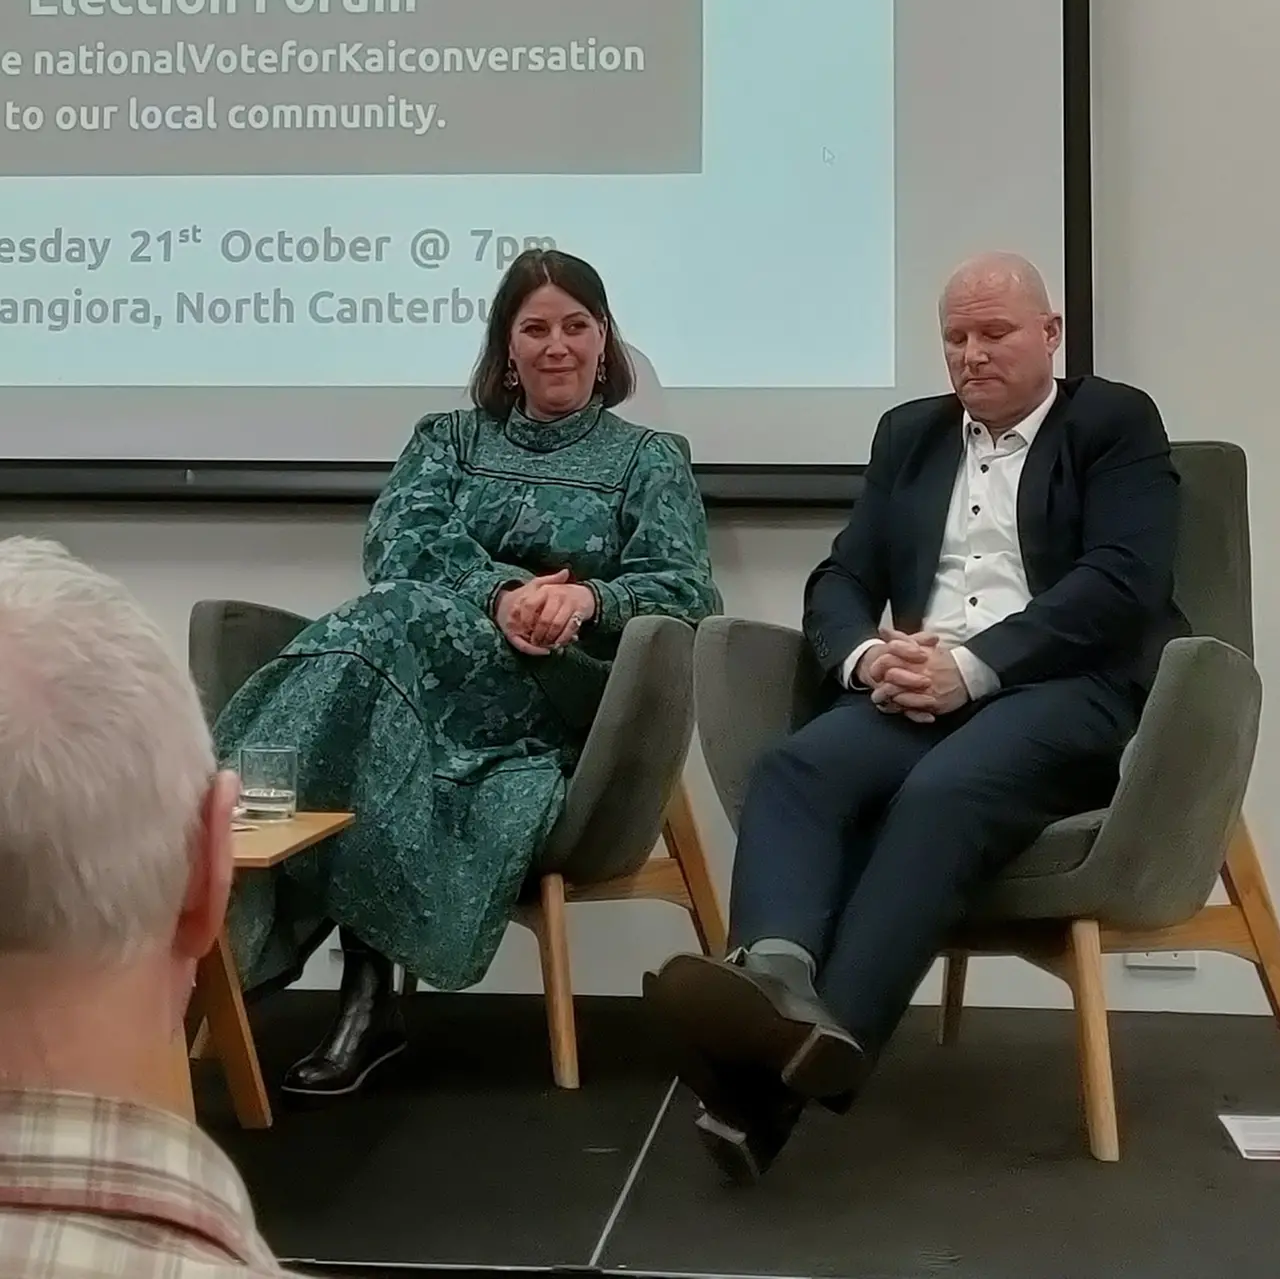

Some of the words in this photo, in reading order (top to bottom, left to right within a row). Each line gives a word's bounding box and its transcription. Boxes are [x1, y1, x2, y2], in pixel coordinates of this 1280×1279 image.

[5, 99, 44, 130] to
[55, 105, 118, 130] our
[129, 96, 217, 130] local
[228, 94, 447, 135] community.
[130, 223, 203, 263] 21st
[220, 226, 392, 263] October
[410, 227, 451, 270] @
[470, 229, 557, 269] 7pm
[176, 287, 295, 324] North
